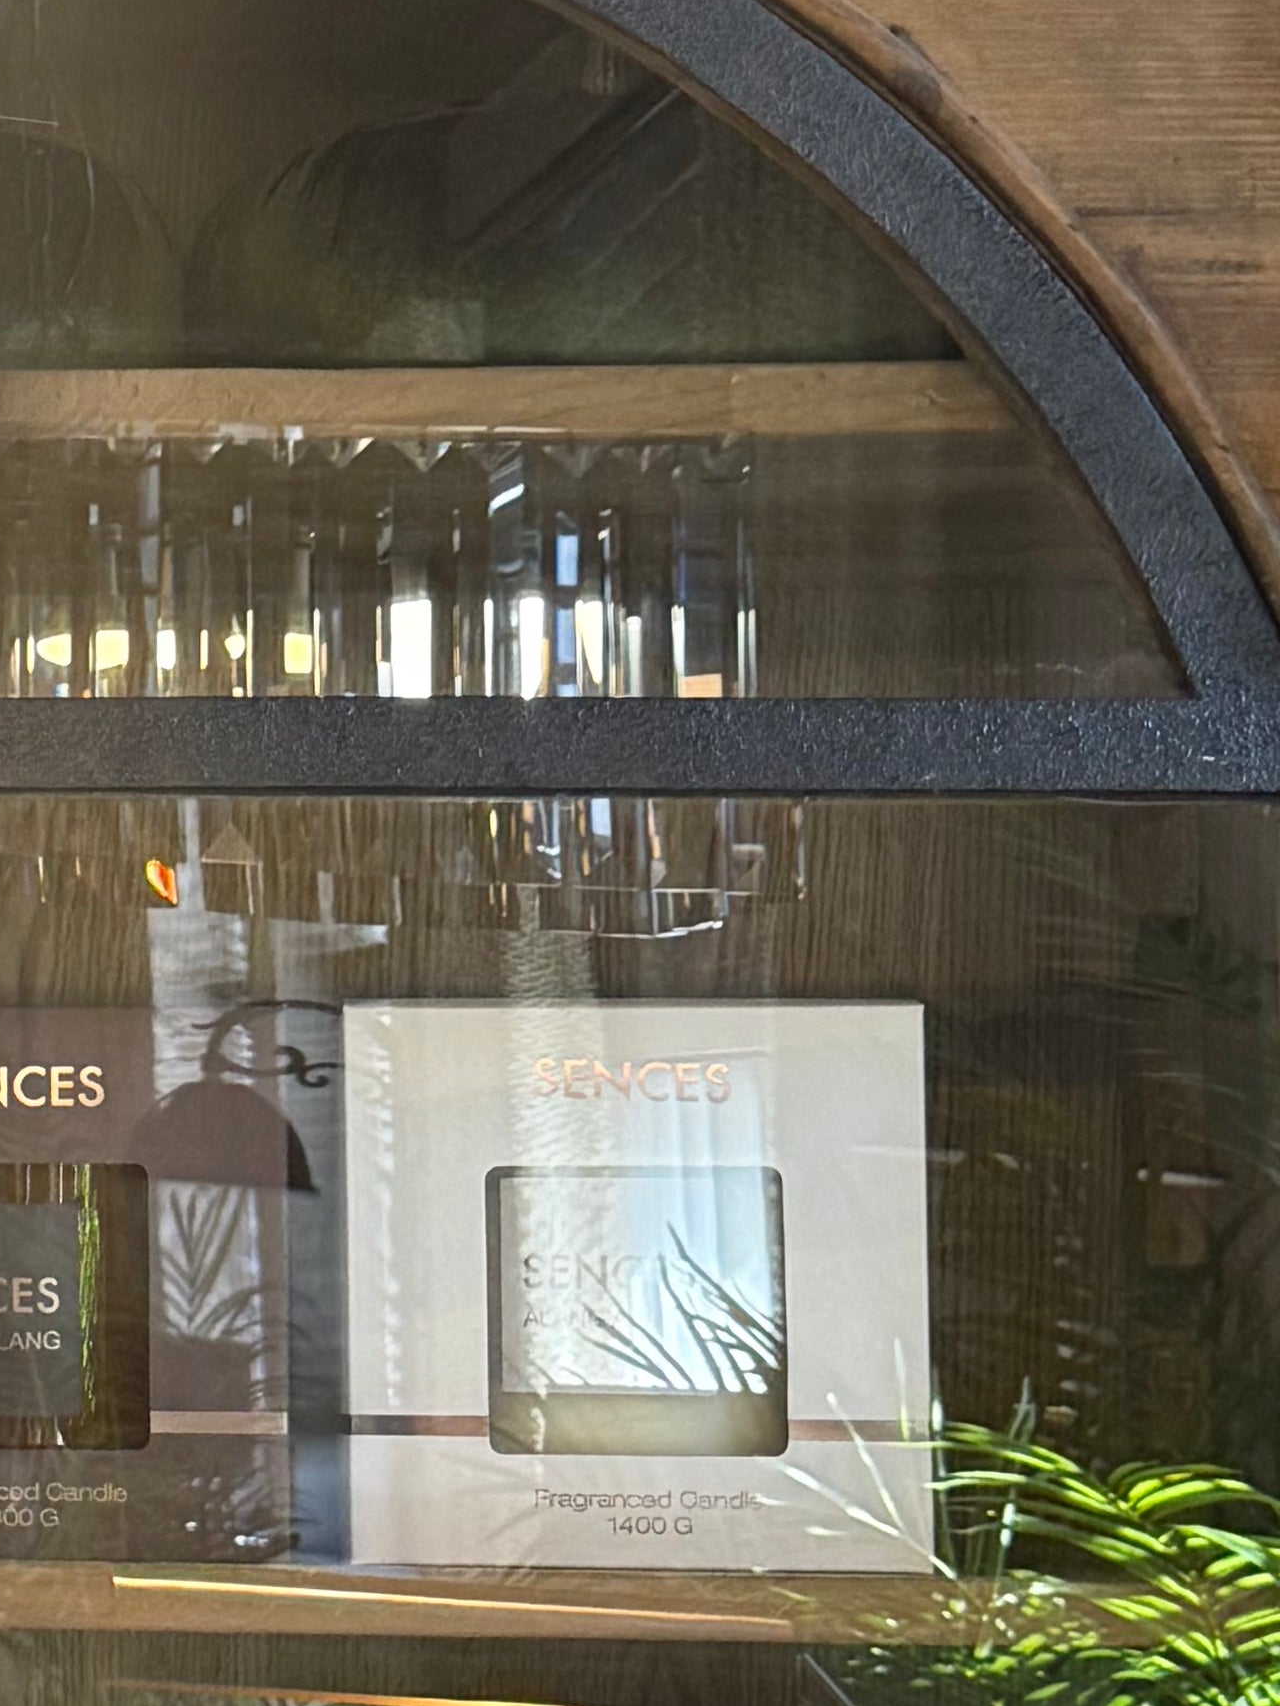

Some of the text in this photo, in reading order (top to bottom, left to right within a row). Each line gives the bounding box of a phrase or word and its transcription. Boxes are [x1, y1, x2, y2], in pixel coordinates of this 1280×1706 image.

[531, 1057, 732, 1104] SENCES
[45, 1481, 128, 1503] Candle
[534, 1488, 763, 1512] Fragranced Candle
[40, 1507, 60, 1528] G
[607, 1516, 694, 1535] 1400 G
